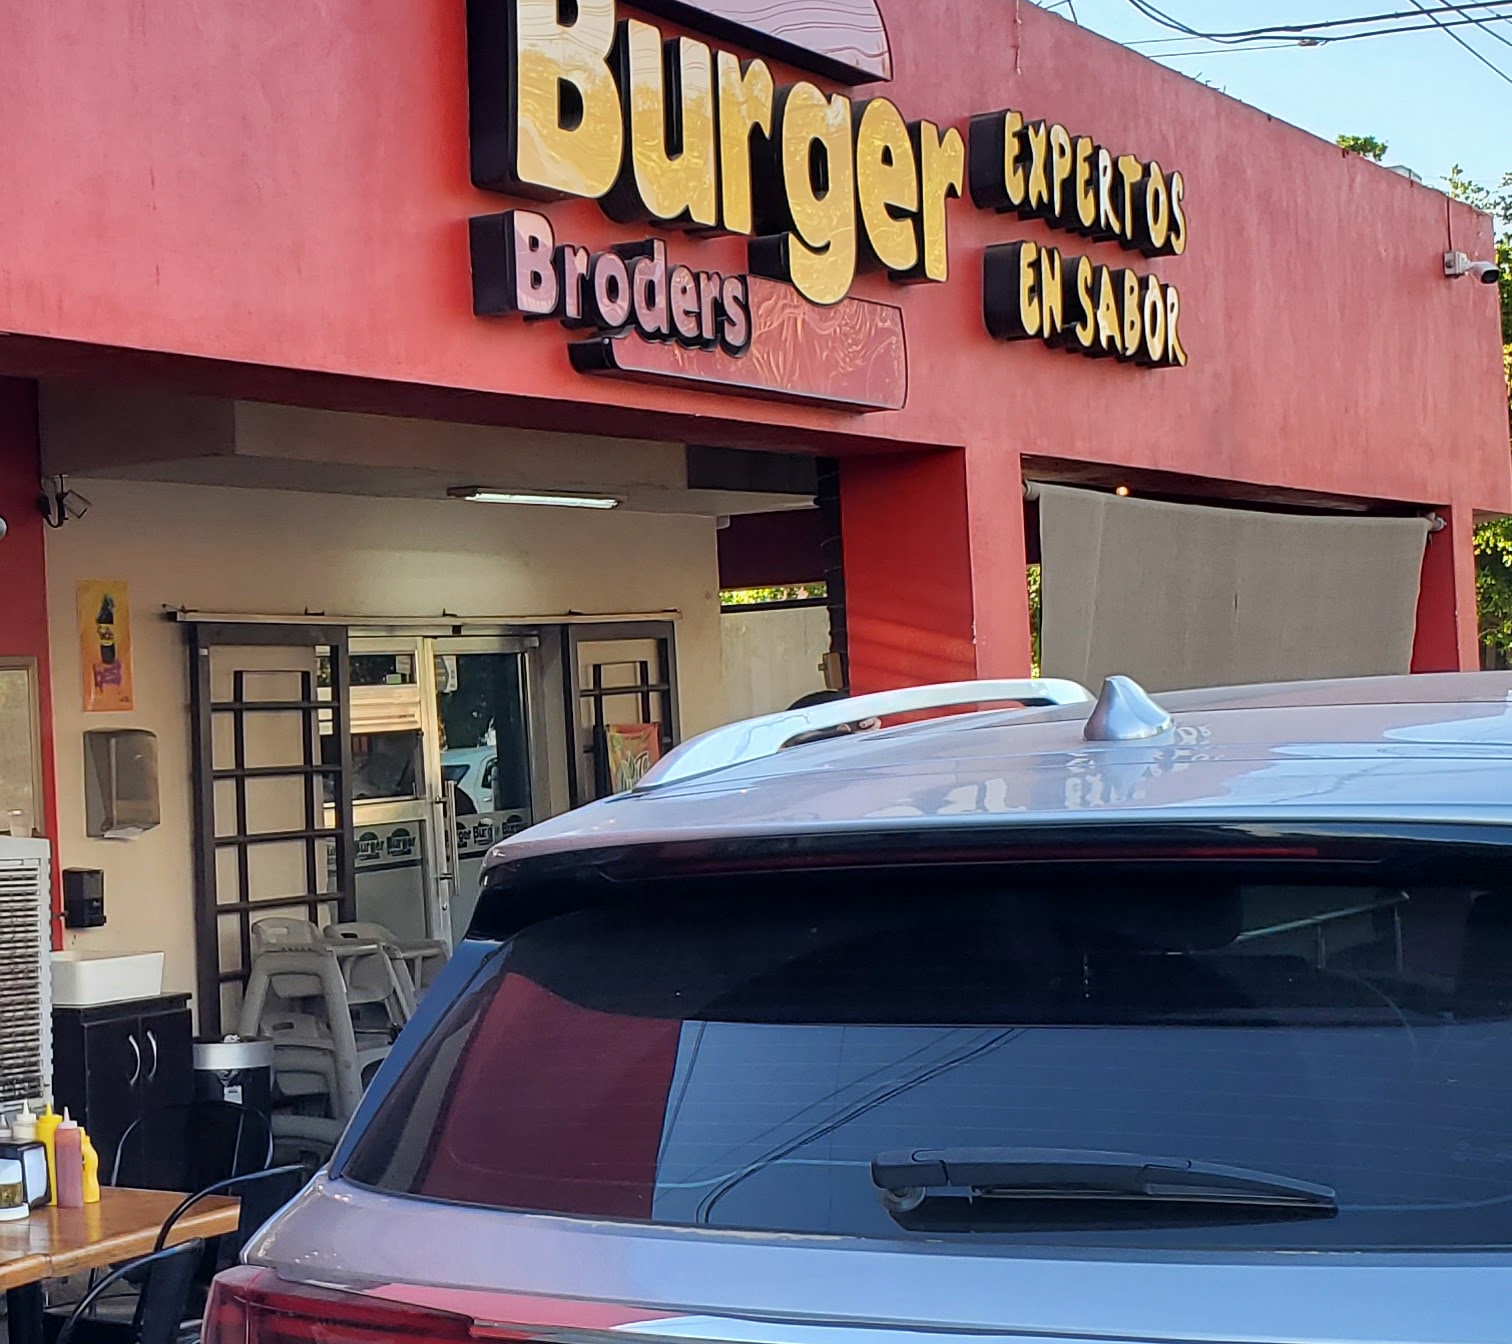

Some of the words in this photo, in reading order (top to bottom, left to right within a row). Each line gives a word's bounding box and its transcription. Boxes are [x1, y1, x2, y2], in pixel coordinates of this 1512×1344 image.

[1004, 111, 1187, 256] EXPERTOS
[514, 209, 751, 359] Broders
[1019, 240, 1063, 339] EN
[1075, 255, 1187, 367] SABOR
